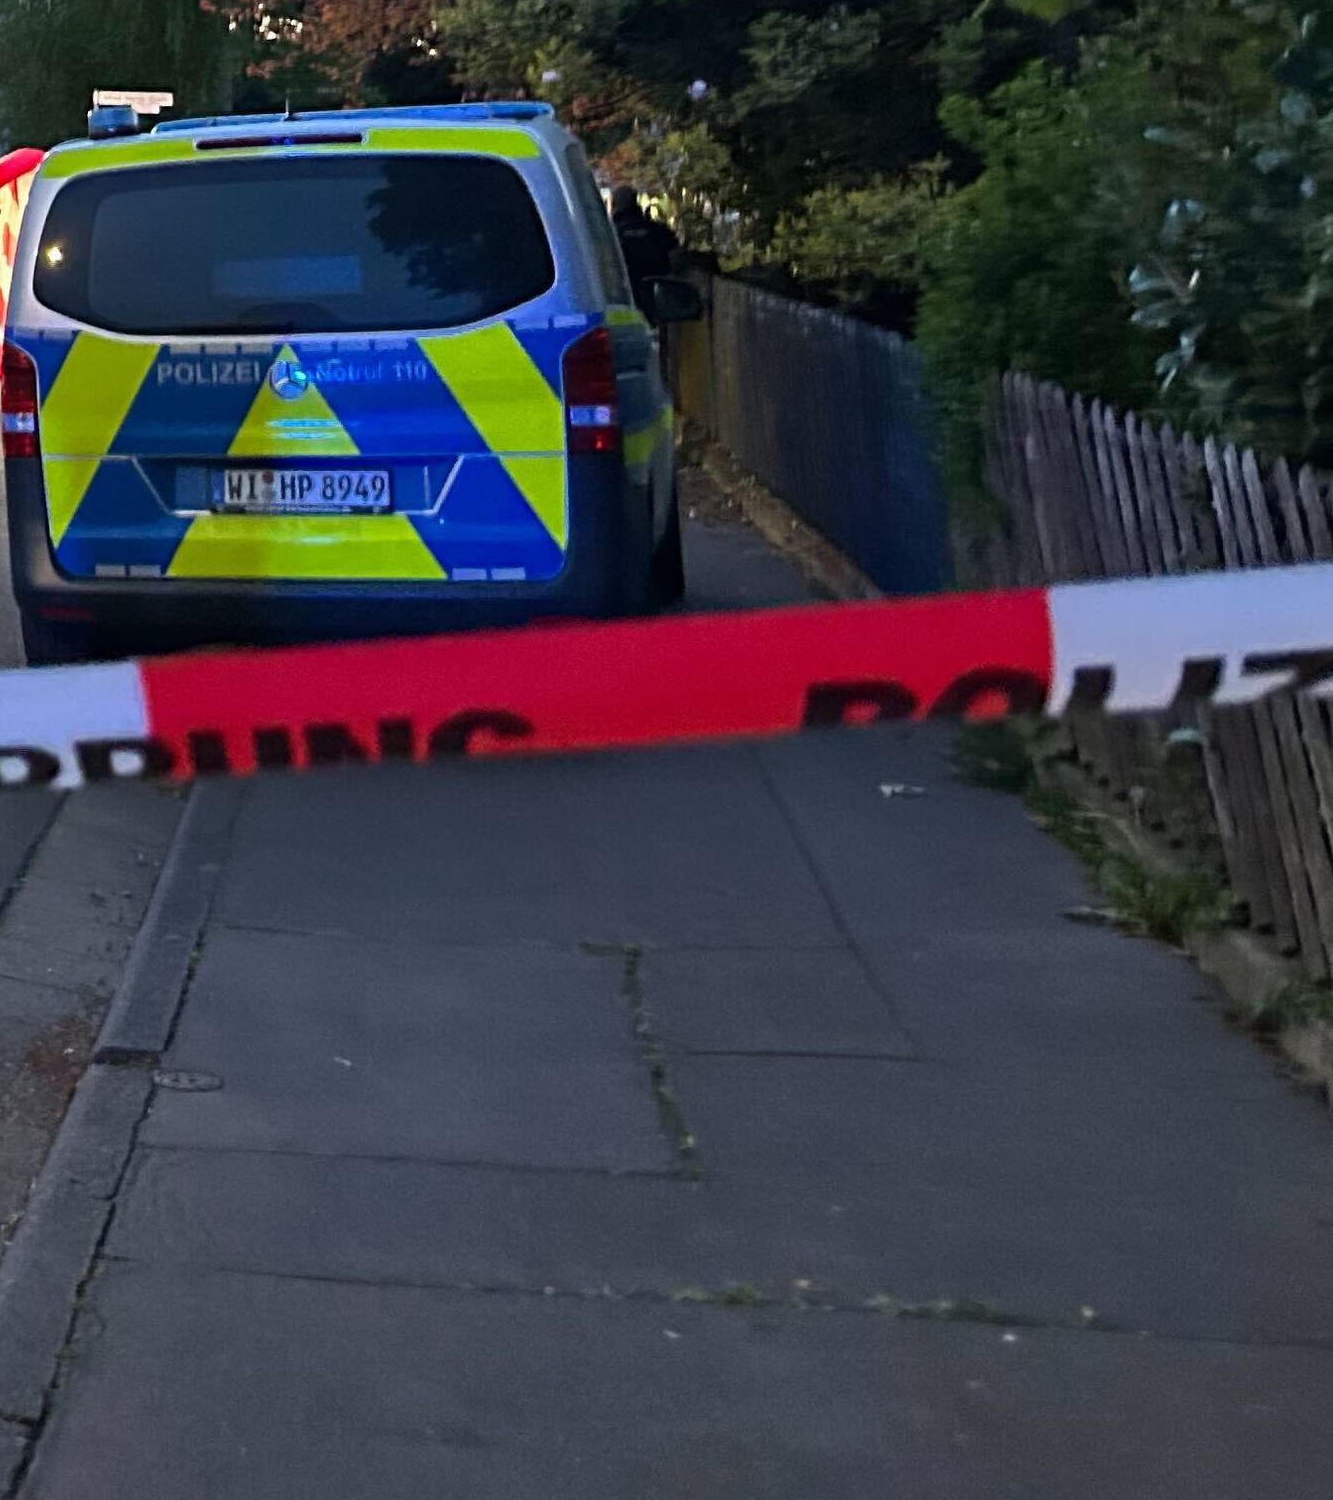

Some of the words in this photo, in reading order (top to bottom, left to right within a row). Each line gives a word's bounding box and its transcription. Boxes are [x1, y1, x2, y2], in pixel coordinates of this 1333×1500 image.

[157, 361, 260, 384] POLIZEI
[279, 473, 313, 501] HP
[321, 473, 386, 502] 8949
